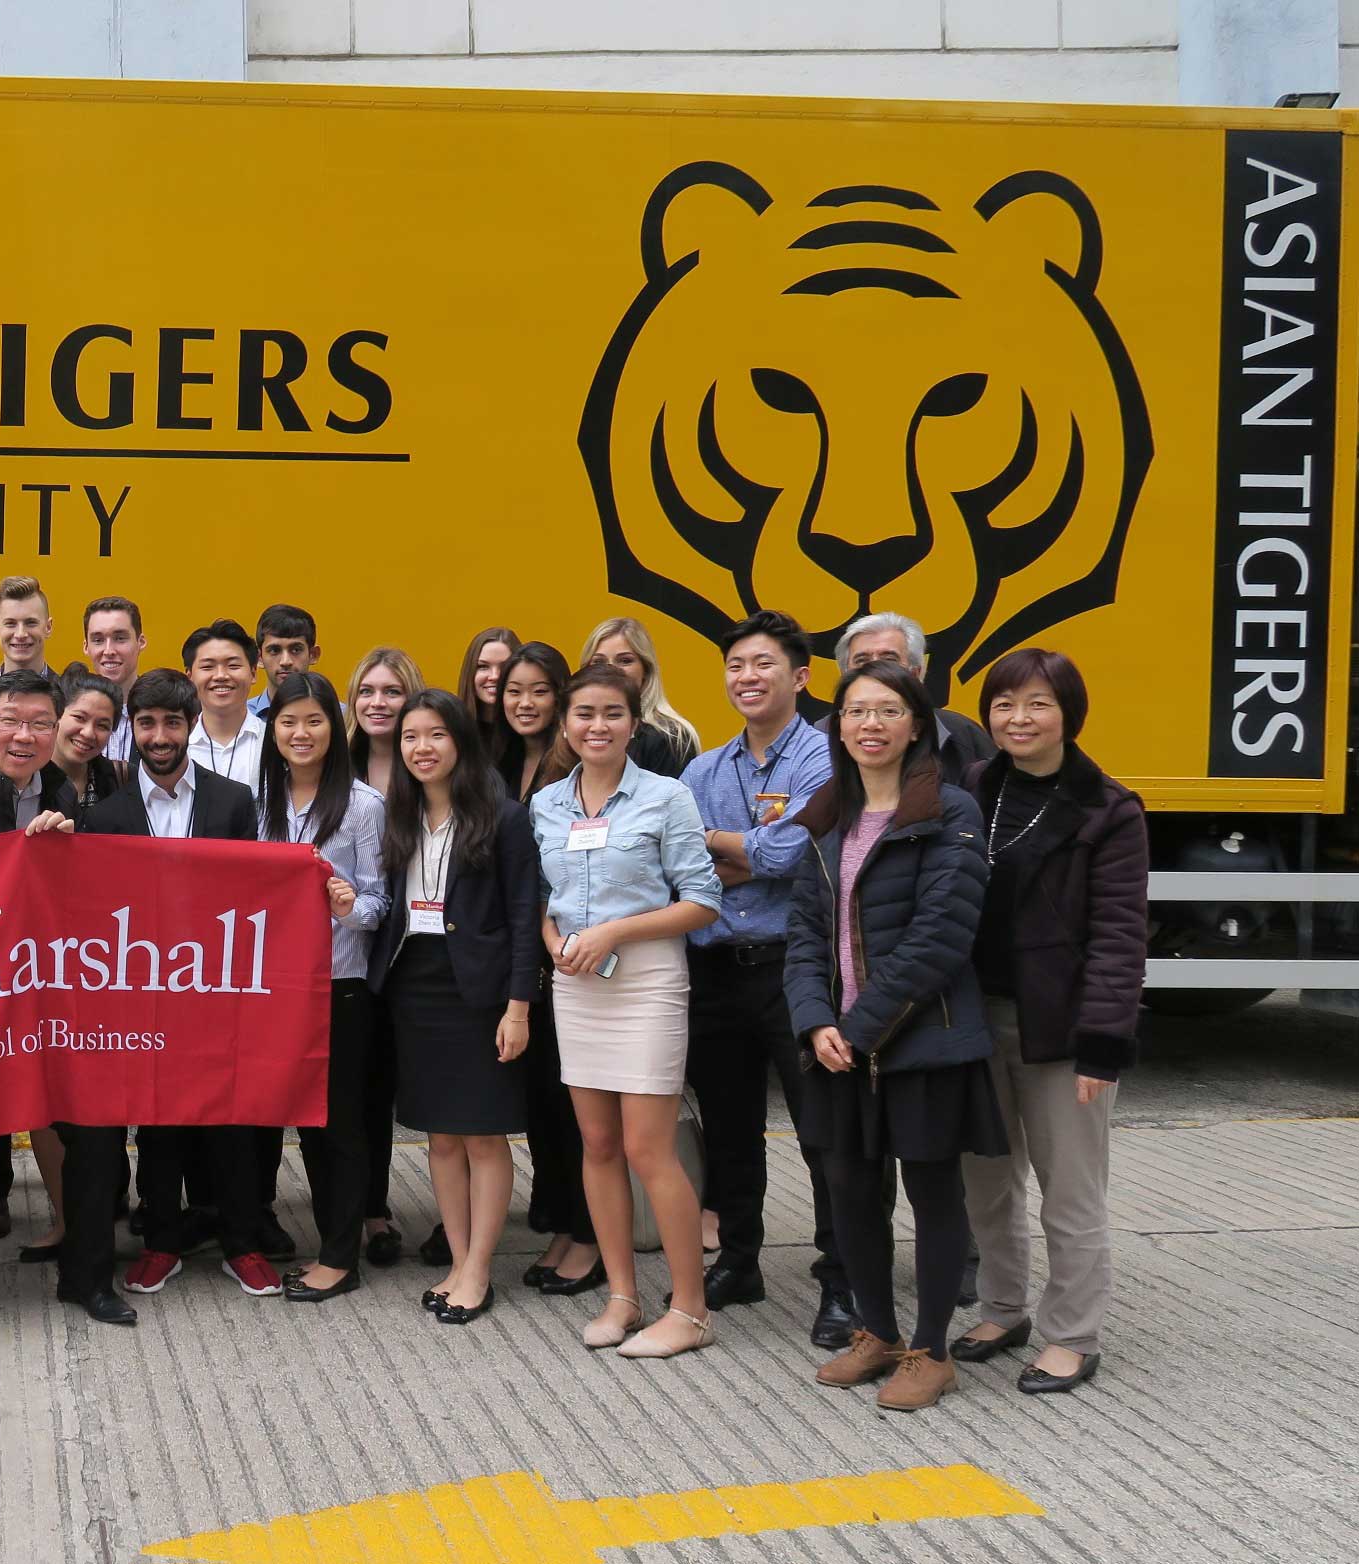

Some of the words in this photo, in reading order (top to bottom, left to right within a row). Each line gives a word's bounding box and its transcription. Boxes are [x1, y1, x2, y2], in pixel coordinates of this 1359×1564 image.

[1242, 157, 1317, 426] ASIAN
[1231, 455, 1312, 757] TIGERS
[21, 1020, 45, 1054] of
[48, 1019, 166, 1051] Business
